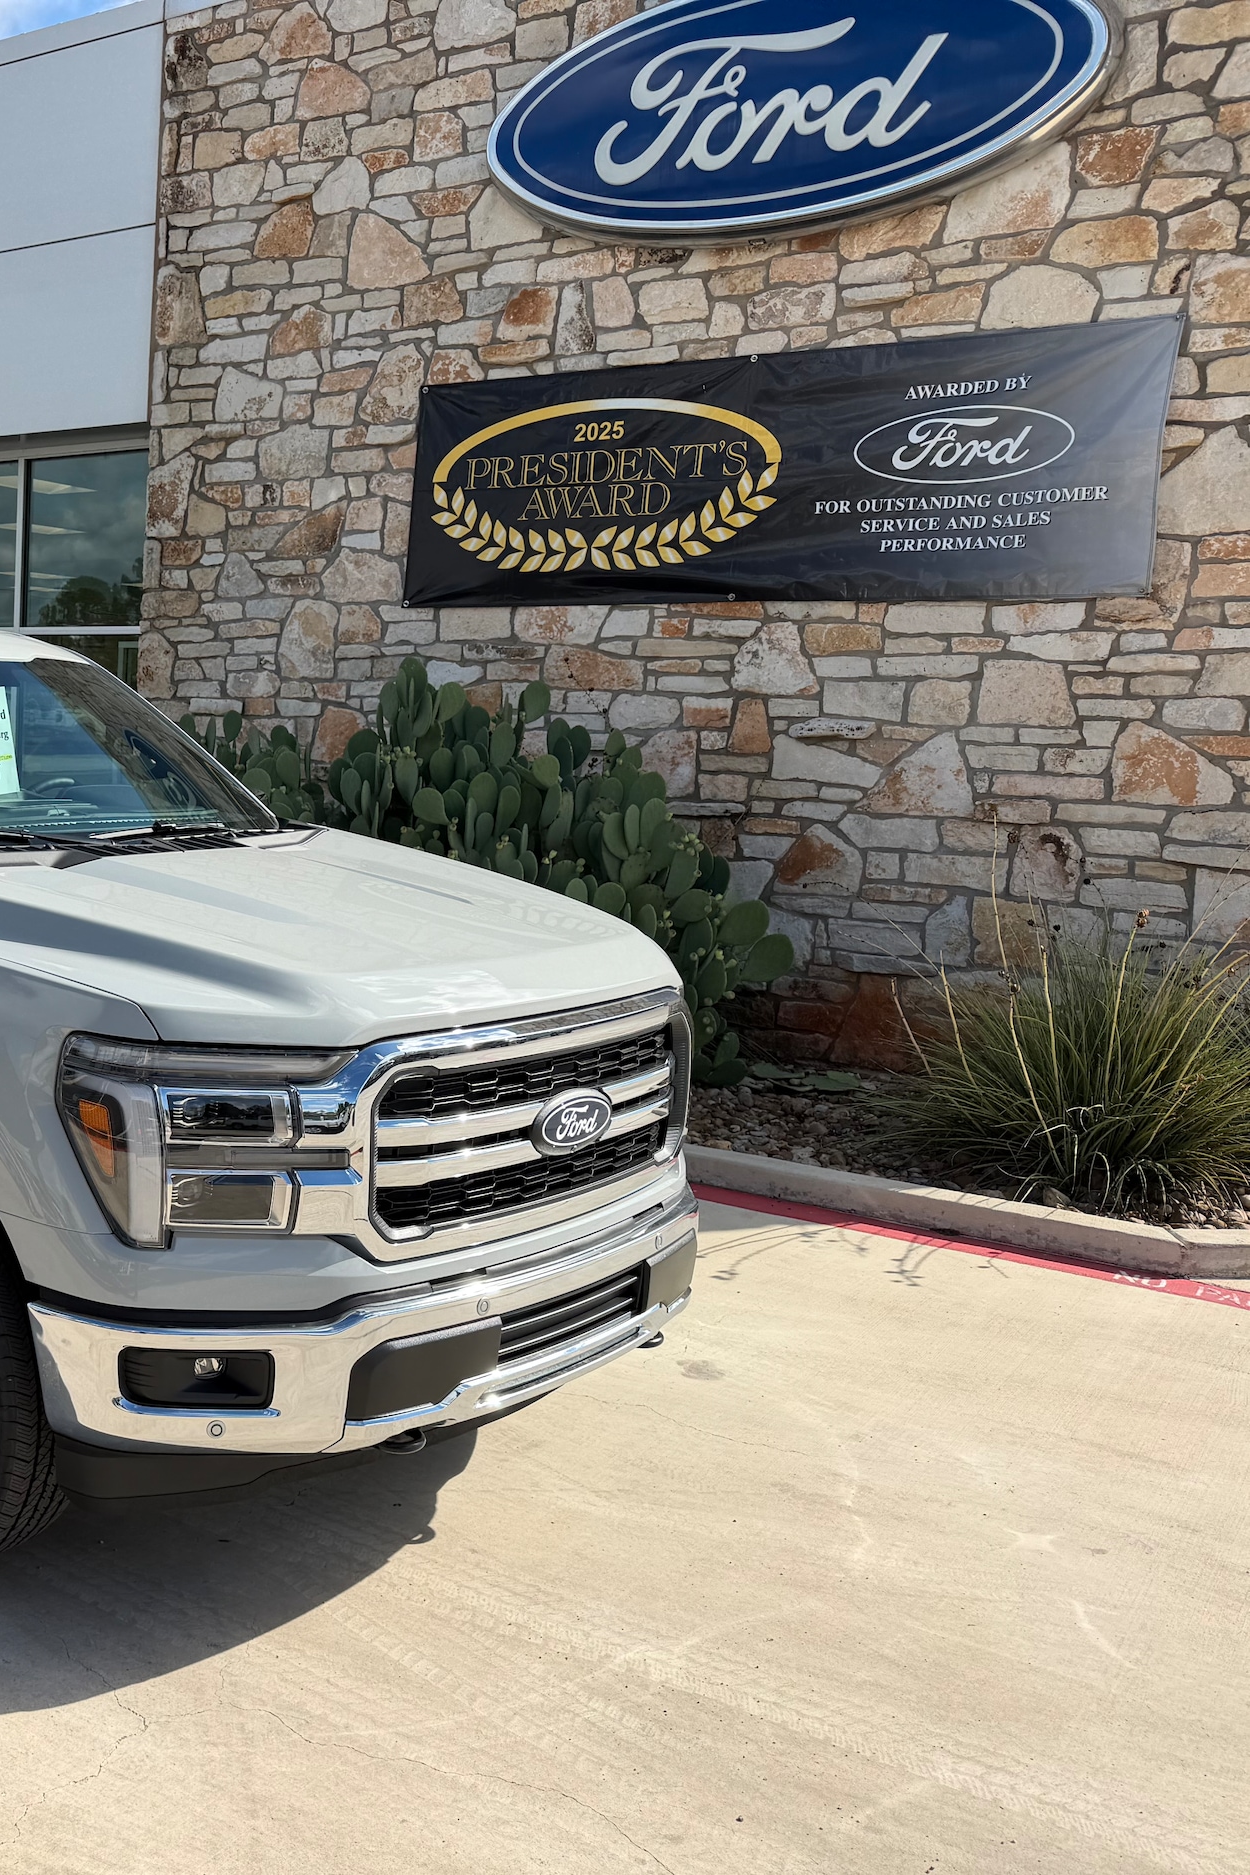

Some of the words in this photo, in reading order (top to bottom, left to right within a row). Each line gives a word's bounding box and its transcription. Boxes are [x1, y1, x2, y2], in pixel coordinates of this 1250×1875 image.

[594, 16, 949, 186] Ford
[904, 379, 1000, 401] AWARDED
[1004, 375, 1033, 392] BY
[573, 420, 625, 443] 2025
[892, 416, 1034, 471] Ford
[464, 440, 749, 491] PRESIDENT'S
[517, 481, 672, 521] AWARD
[814, 500, 852, 515] FOR
[856, 493, 992, 514] OUTSTANDING
[997, 485, 1110, 507] CUSTOMER
[860, 517, 940, 534] SERVICE
[945, 515, 987, 531] AND
[991, 510, 1052, 529] SALES
[879, 534, 1027, 553] PERFORMANCE
[556, 1104, 599, 1140] Ford
[1195, 1284, 1250, 1307] PA
